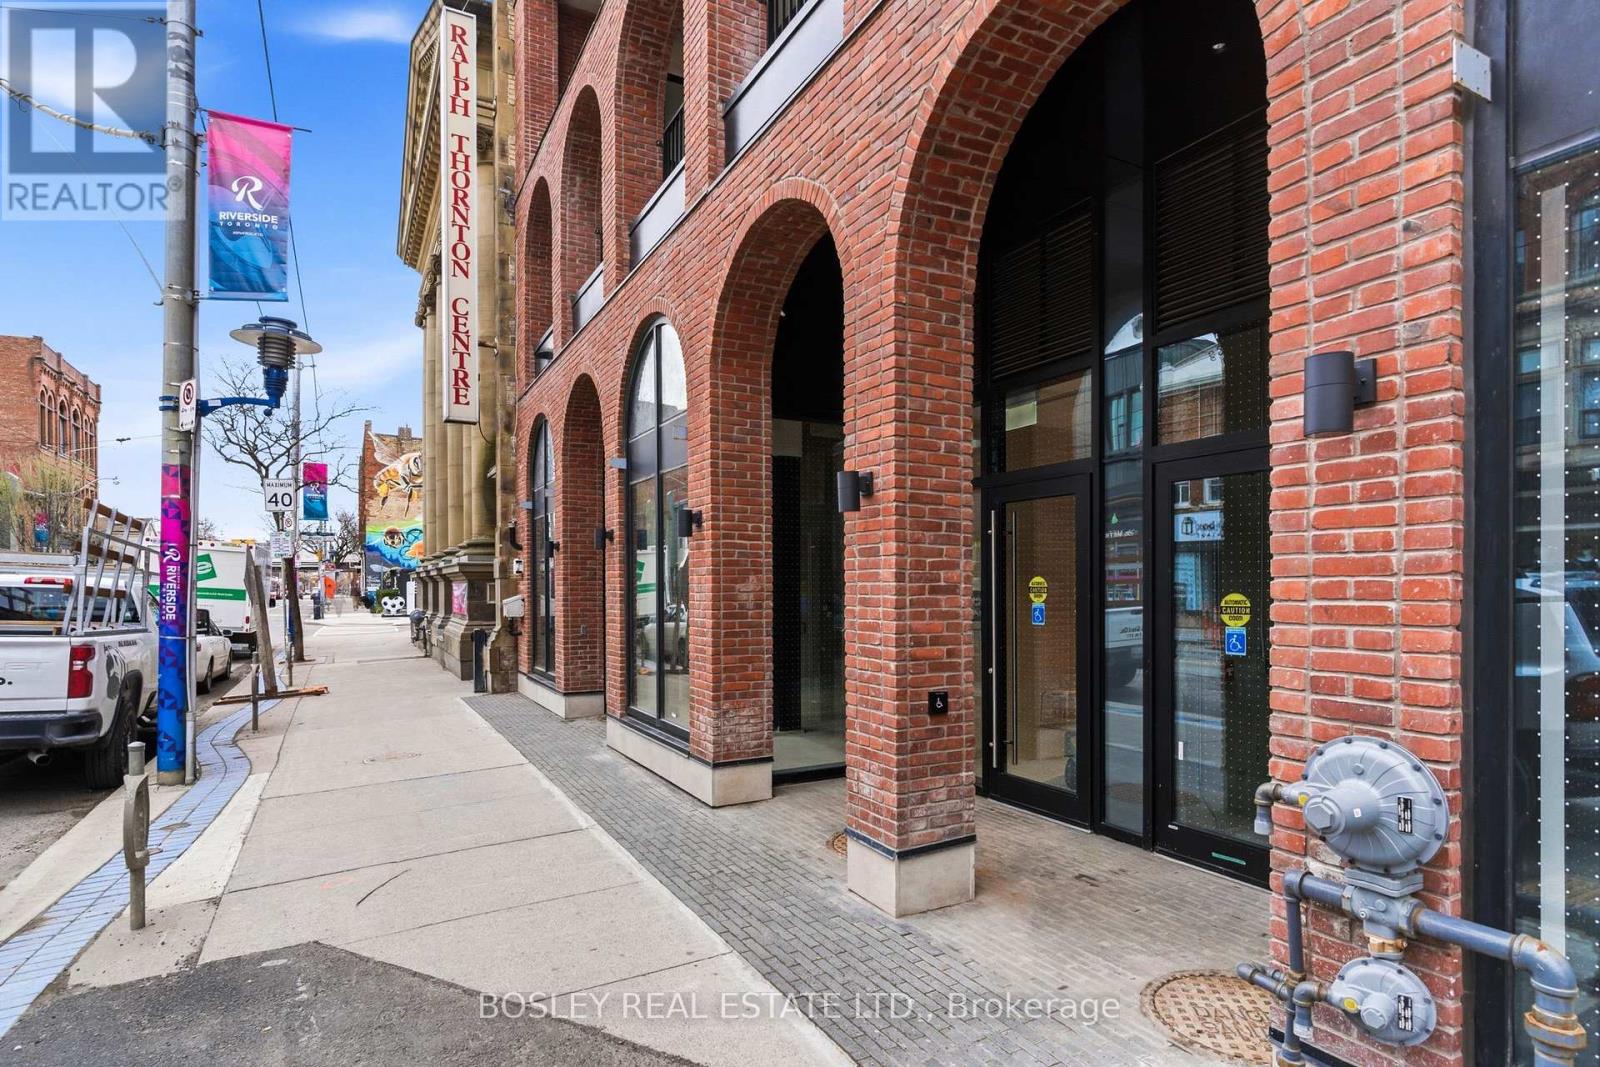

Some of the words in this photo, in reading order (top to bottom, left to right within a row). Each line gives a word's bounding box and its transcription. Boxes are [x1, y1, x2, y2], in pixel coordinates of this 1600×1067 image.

[450, 24, 471, 118] RALPH
[219, 211, 279, 224] RIVERSIDE
[219, 221, 279, 230] TORONTO
[450, 133, 471, 279] THORNTON
[451, 297, 471, 406] CENTRE
[267, 493, 293, 507] 40
[165, 565, 177, 620] RIVERSIDE
